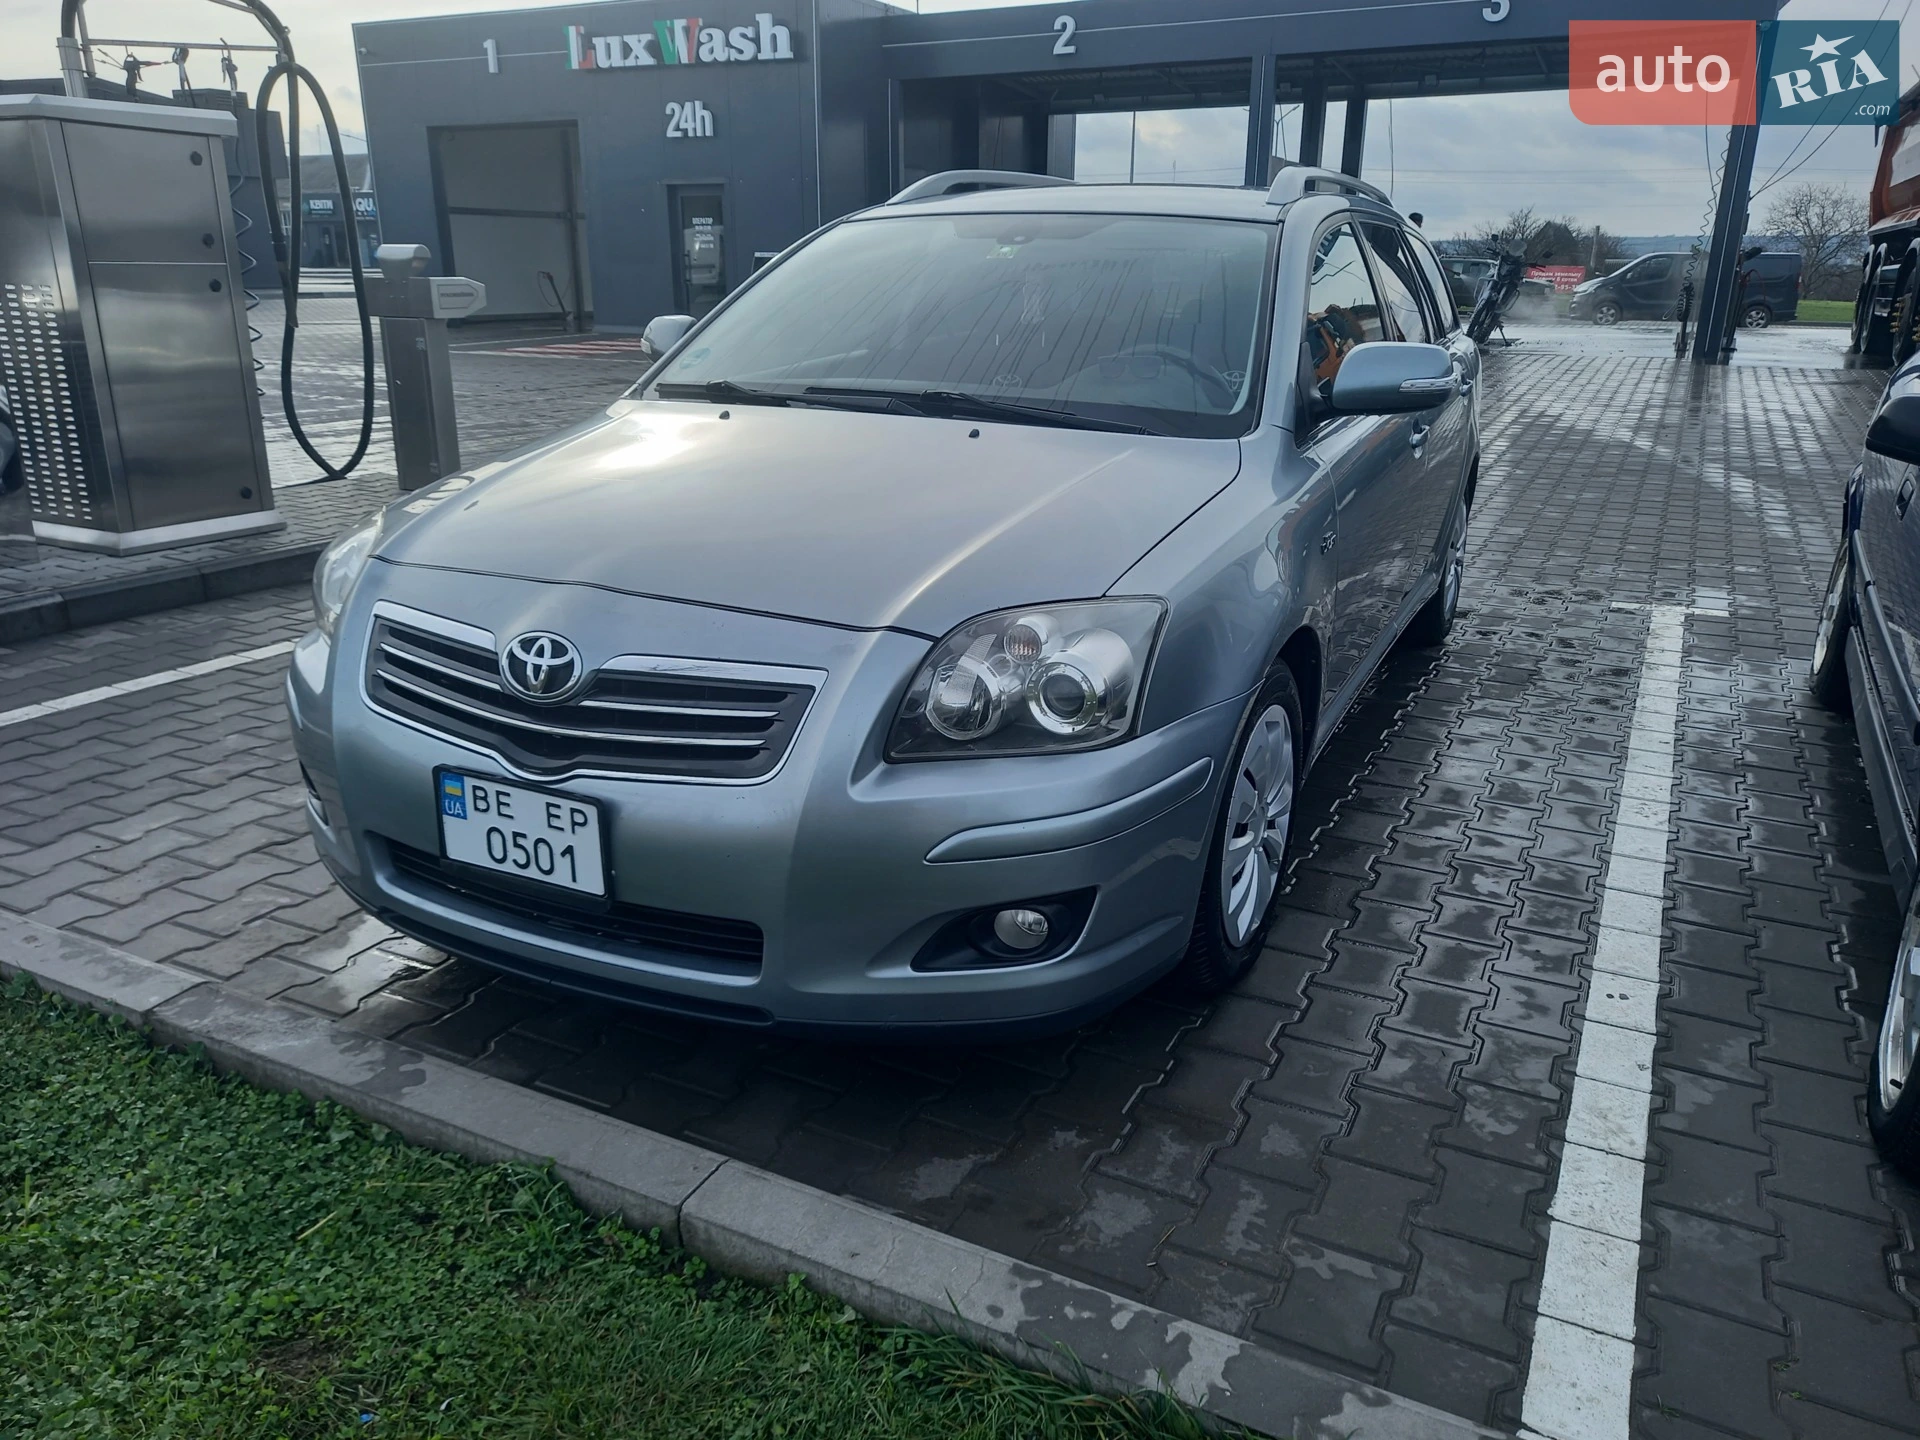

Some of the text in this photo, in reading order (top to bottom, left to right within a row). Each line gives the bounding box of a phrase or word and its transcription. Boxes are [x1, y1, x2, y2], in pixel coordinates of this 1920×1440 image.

[563, 13, 793, 70] LuxWash
[1053, 15, 1077, 55] 2
[483, 39, 499, 73] 1
[665, 100, 714, 137] 24h
[445, 800, 464, 817] UA
[472, 784, 588, 835] BE EP
[486, 826, 577, 883] 0501
